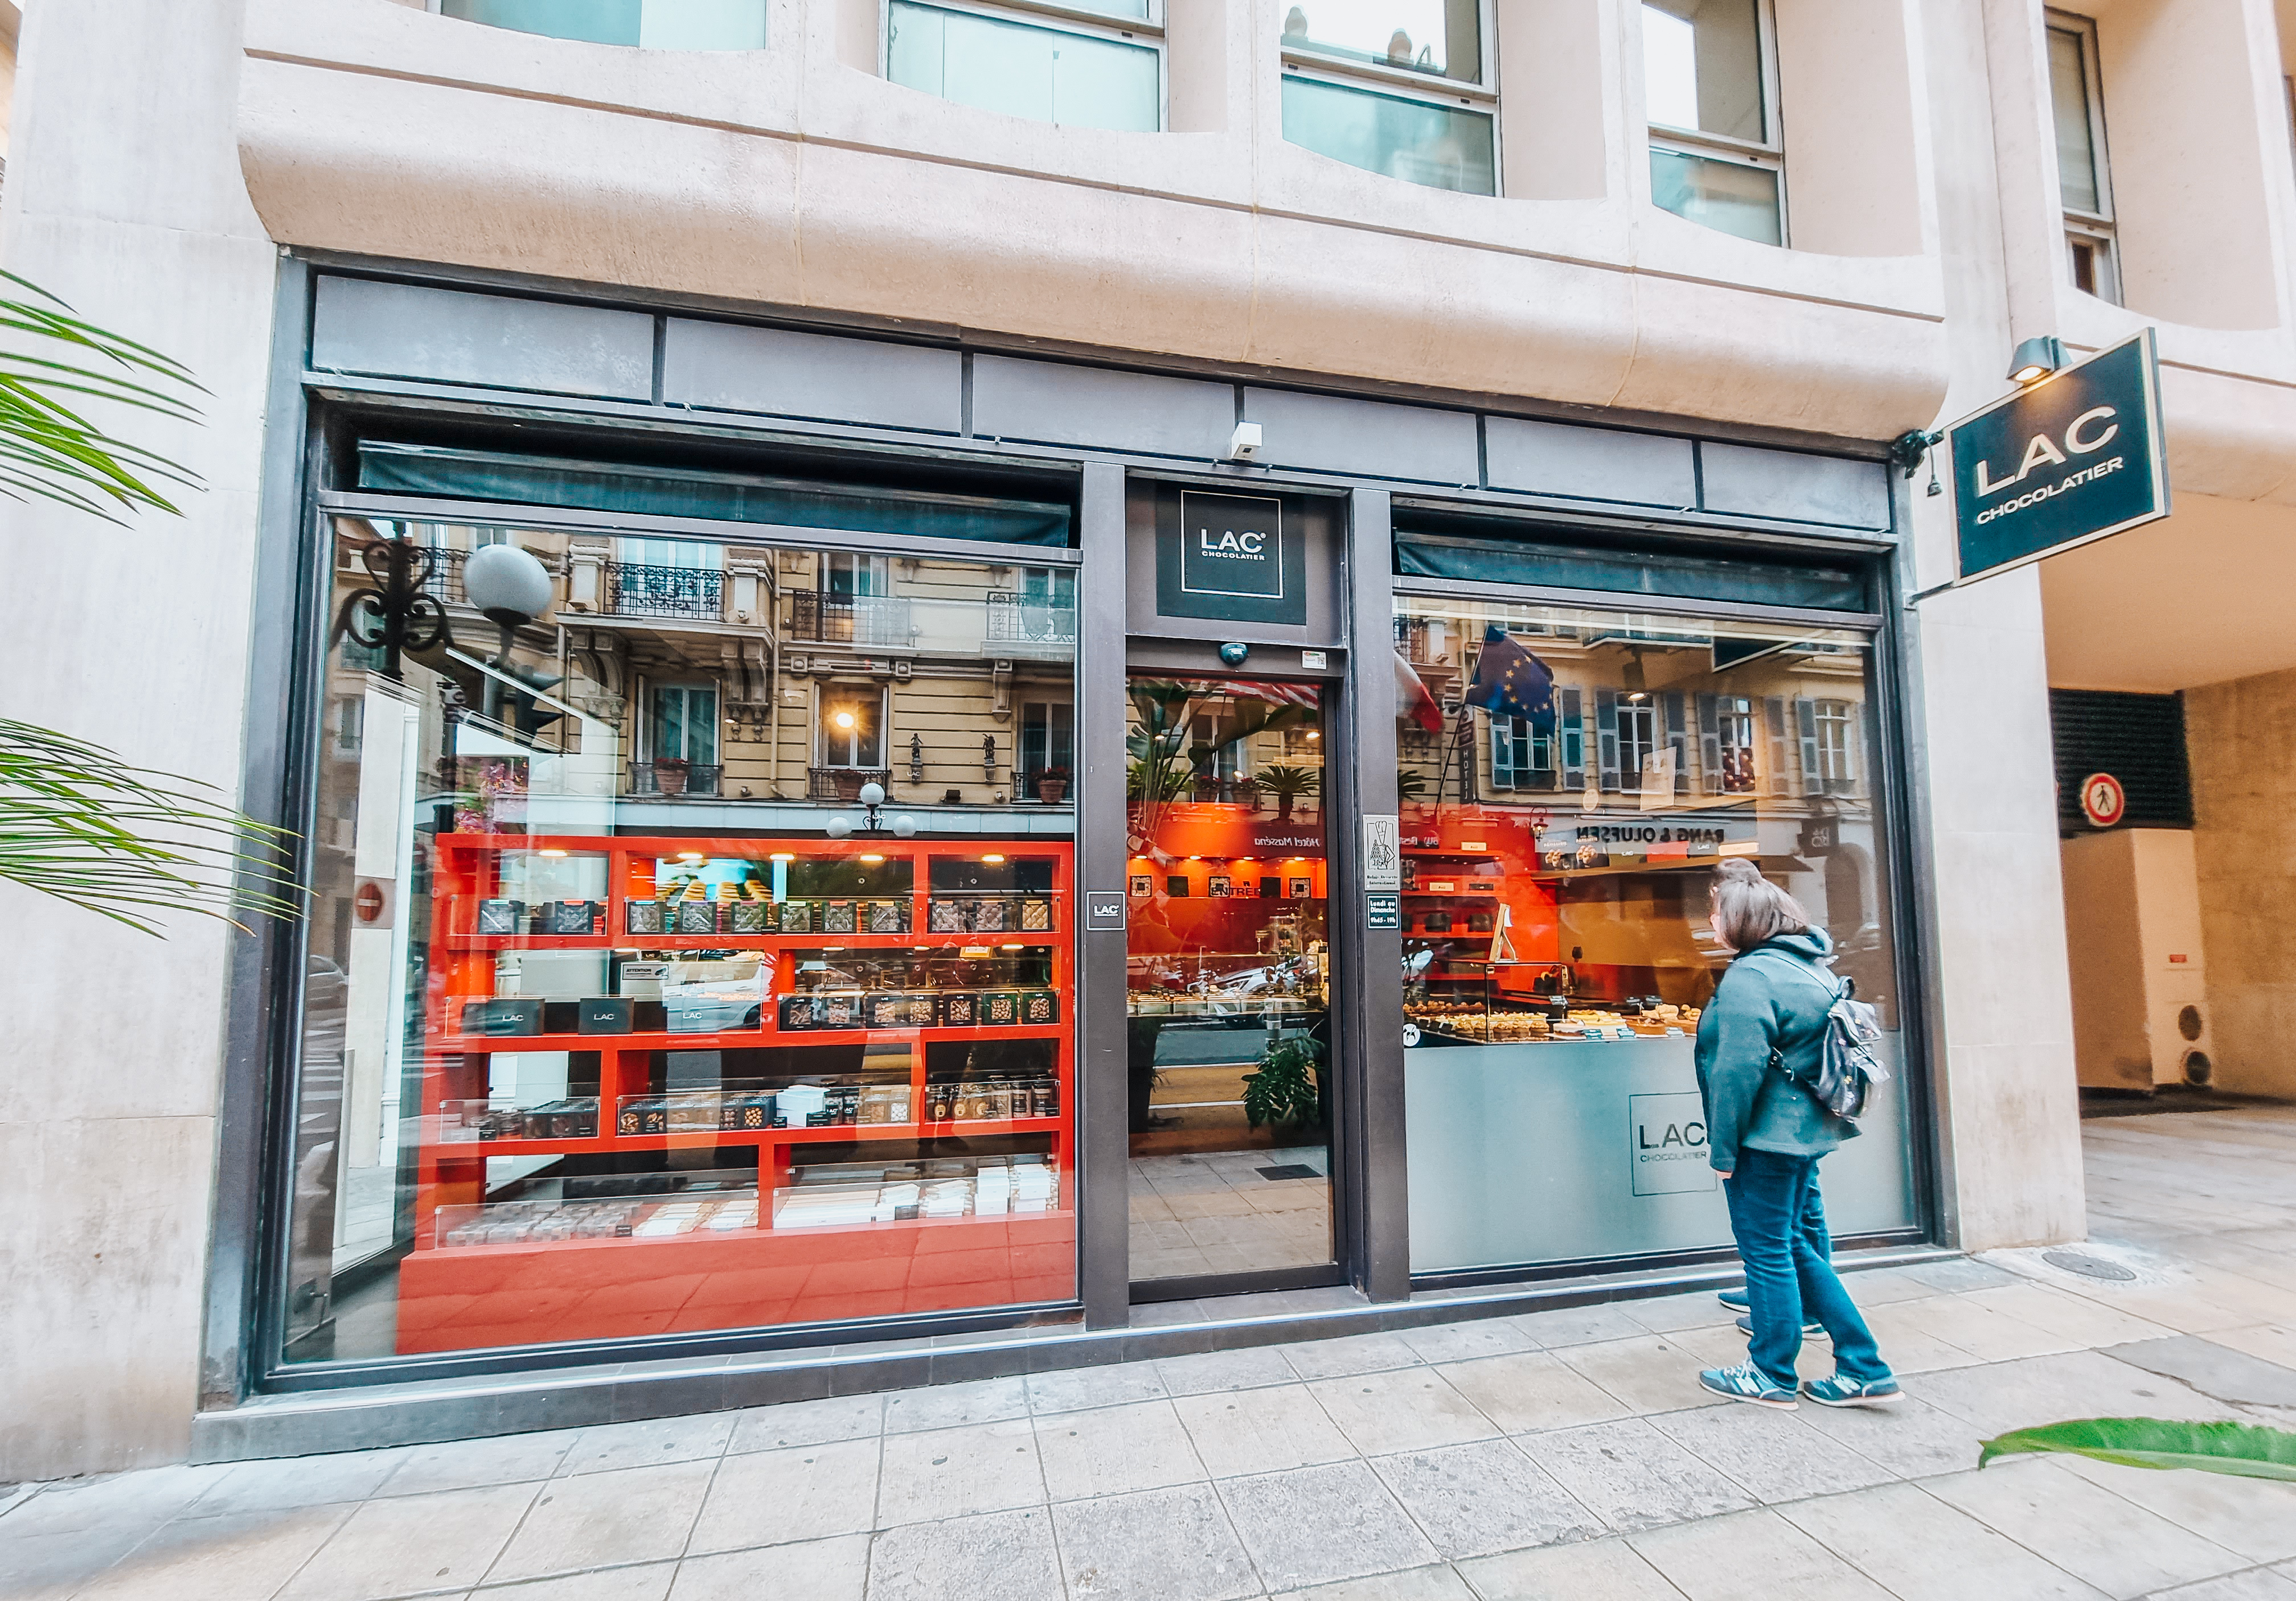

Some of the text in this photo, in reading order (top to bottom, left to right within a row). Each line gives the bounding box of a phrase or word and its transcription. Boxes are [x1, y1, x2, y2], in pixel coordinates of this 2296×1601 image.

[1977, 407, 2118, 498] LAC
[1977, 456, 2124, 525] CHOCOLATIER
[1202, 551, 1265, 560] CHOCOLATIER
[1639, 1122, 1705, 1150] LAC
[1640, 1151, 1707, 1162] CHOCOLATIER
